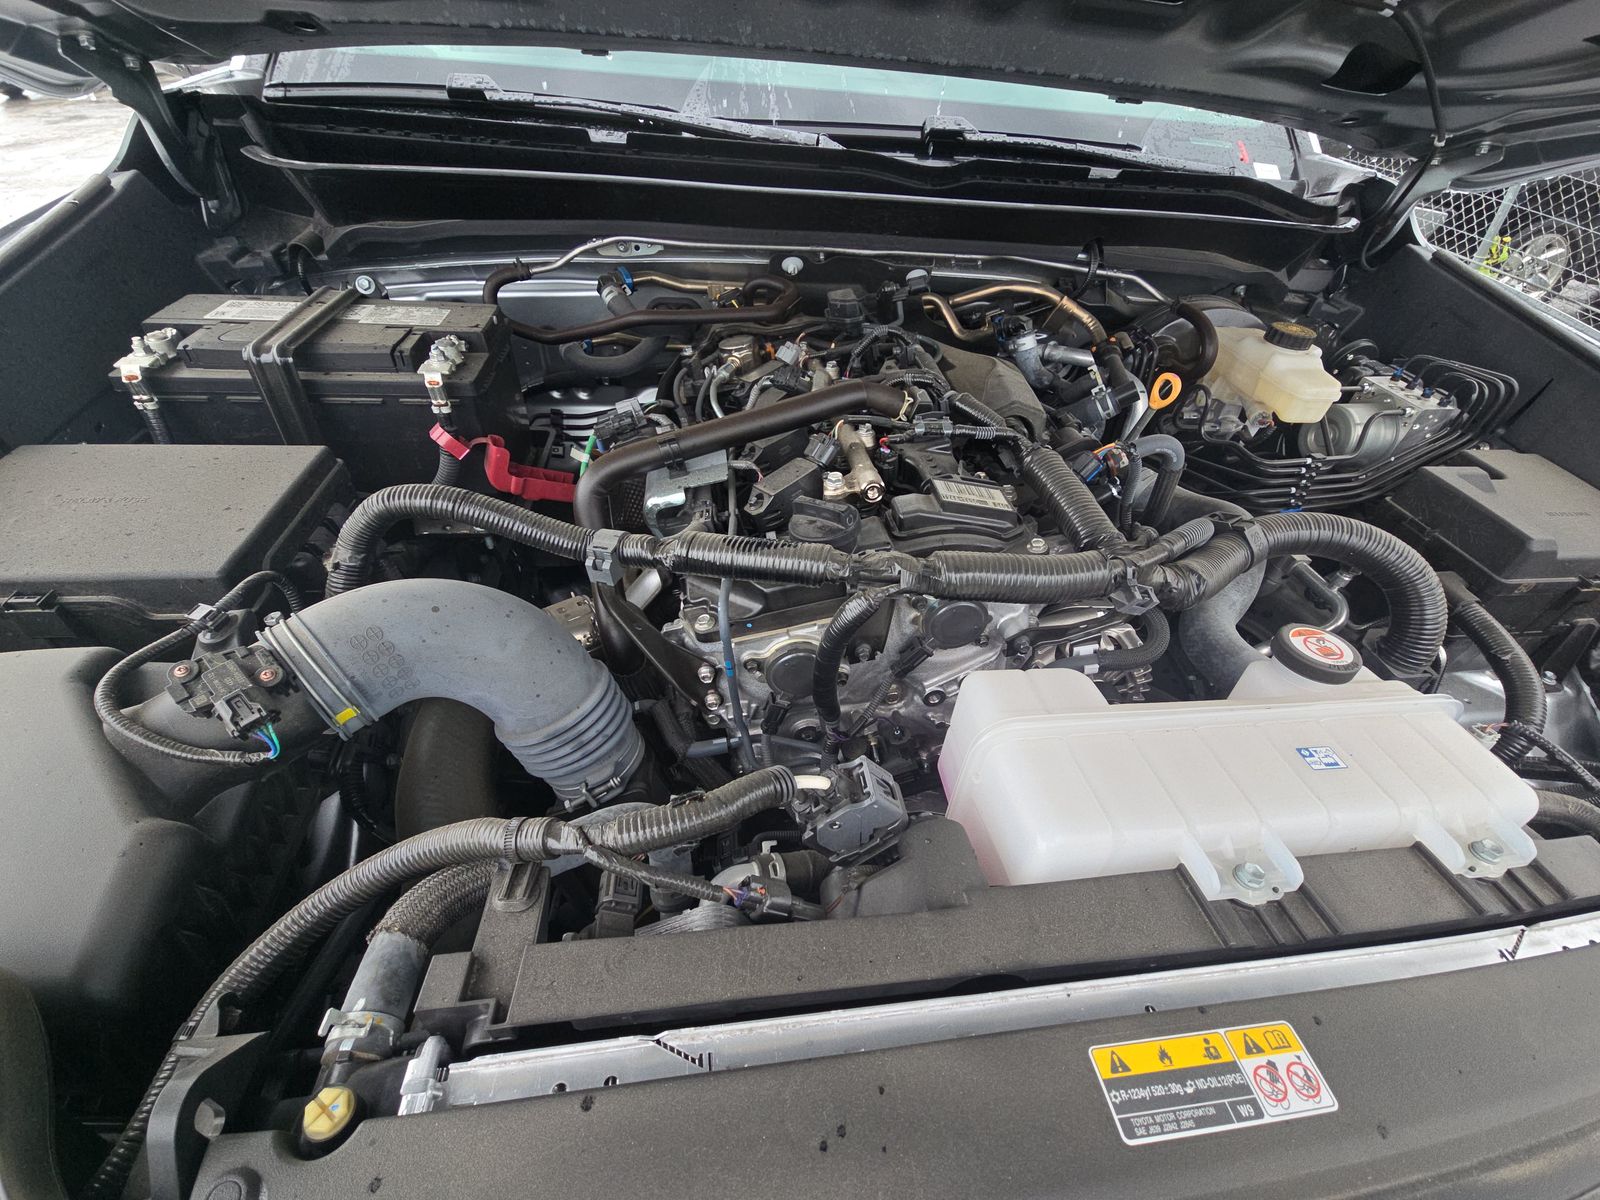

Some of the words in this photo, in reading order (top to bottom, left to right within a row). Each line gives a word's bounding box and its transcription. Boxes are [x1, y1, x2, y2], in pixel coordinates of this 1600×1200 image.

[1120, 1085, 1151, 1101] R-1234yf
[1195, 1074, 1247, 1090] ND-OIL12(POE)
[1130, 1116, 1154, 1126] TOYOTA
[1154, 1113, 1176, 1123] MOTOR
[1176, 1107, 1216, 1120] CORPORATION
[1237, 1104, 1255, 1117] W9
[1134, 1126, 1148, 1136] SAE
